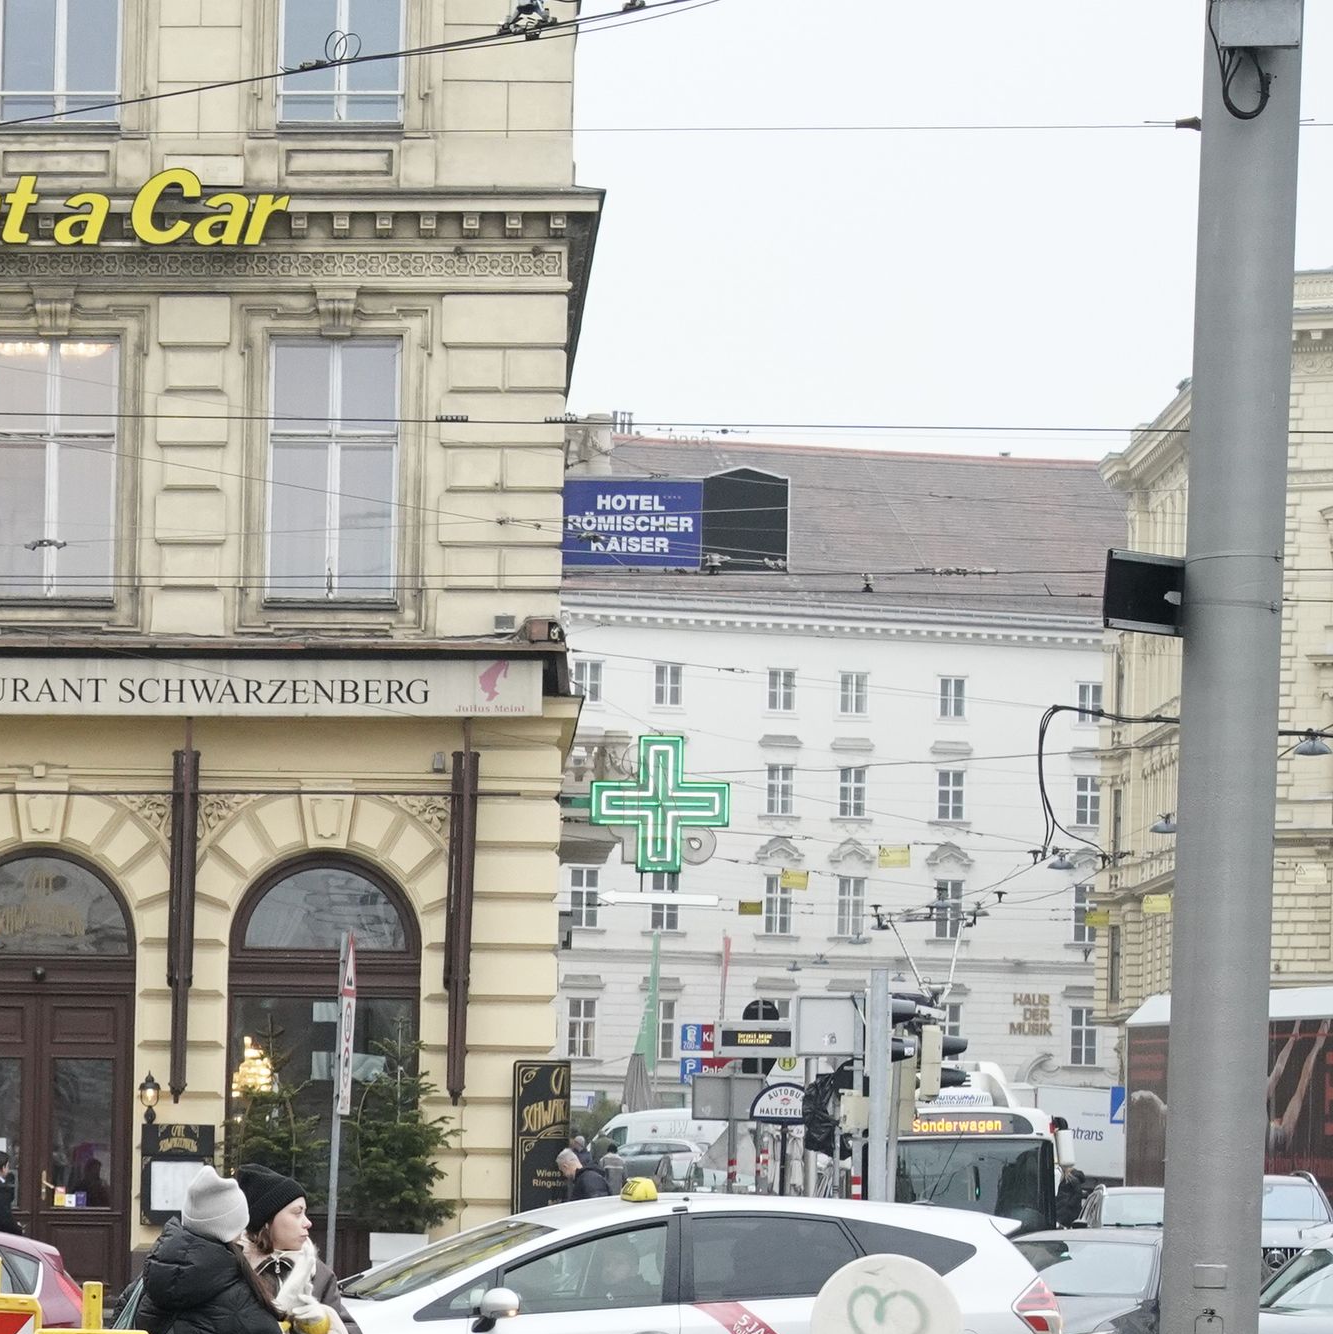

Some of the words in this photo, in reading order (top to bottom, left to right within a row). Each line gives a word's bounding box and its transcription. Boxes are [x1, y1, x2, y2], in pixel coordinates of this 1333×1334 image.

[53, 192, 111, 246] a
[130, 167, 290, 246] Car
[596, 494, 666, 511] HOTEL
[567, 511, 694, 533] RÖMISCHER
[590, 536, 670, 553] KAISER
[118, 677, 430, 706] SCHWARZENBERG
[1013, 992, 1050, 1007] HAUS
[1023, 1007, 1050, 1021] DER
[1008, 1021, 1053, 1036] MUSIK
[782, 1058, 792, 1068] H
[767, 1087, 806, 1101] AUTOBU
[759, 1108, 804, 1116] HALTESTEL
[912, 1118, 1002, 1133] Sonderwagen
[535, 1169, 562, 1178] Wiens
[737, 1313, 751, 1326] 5
